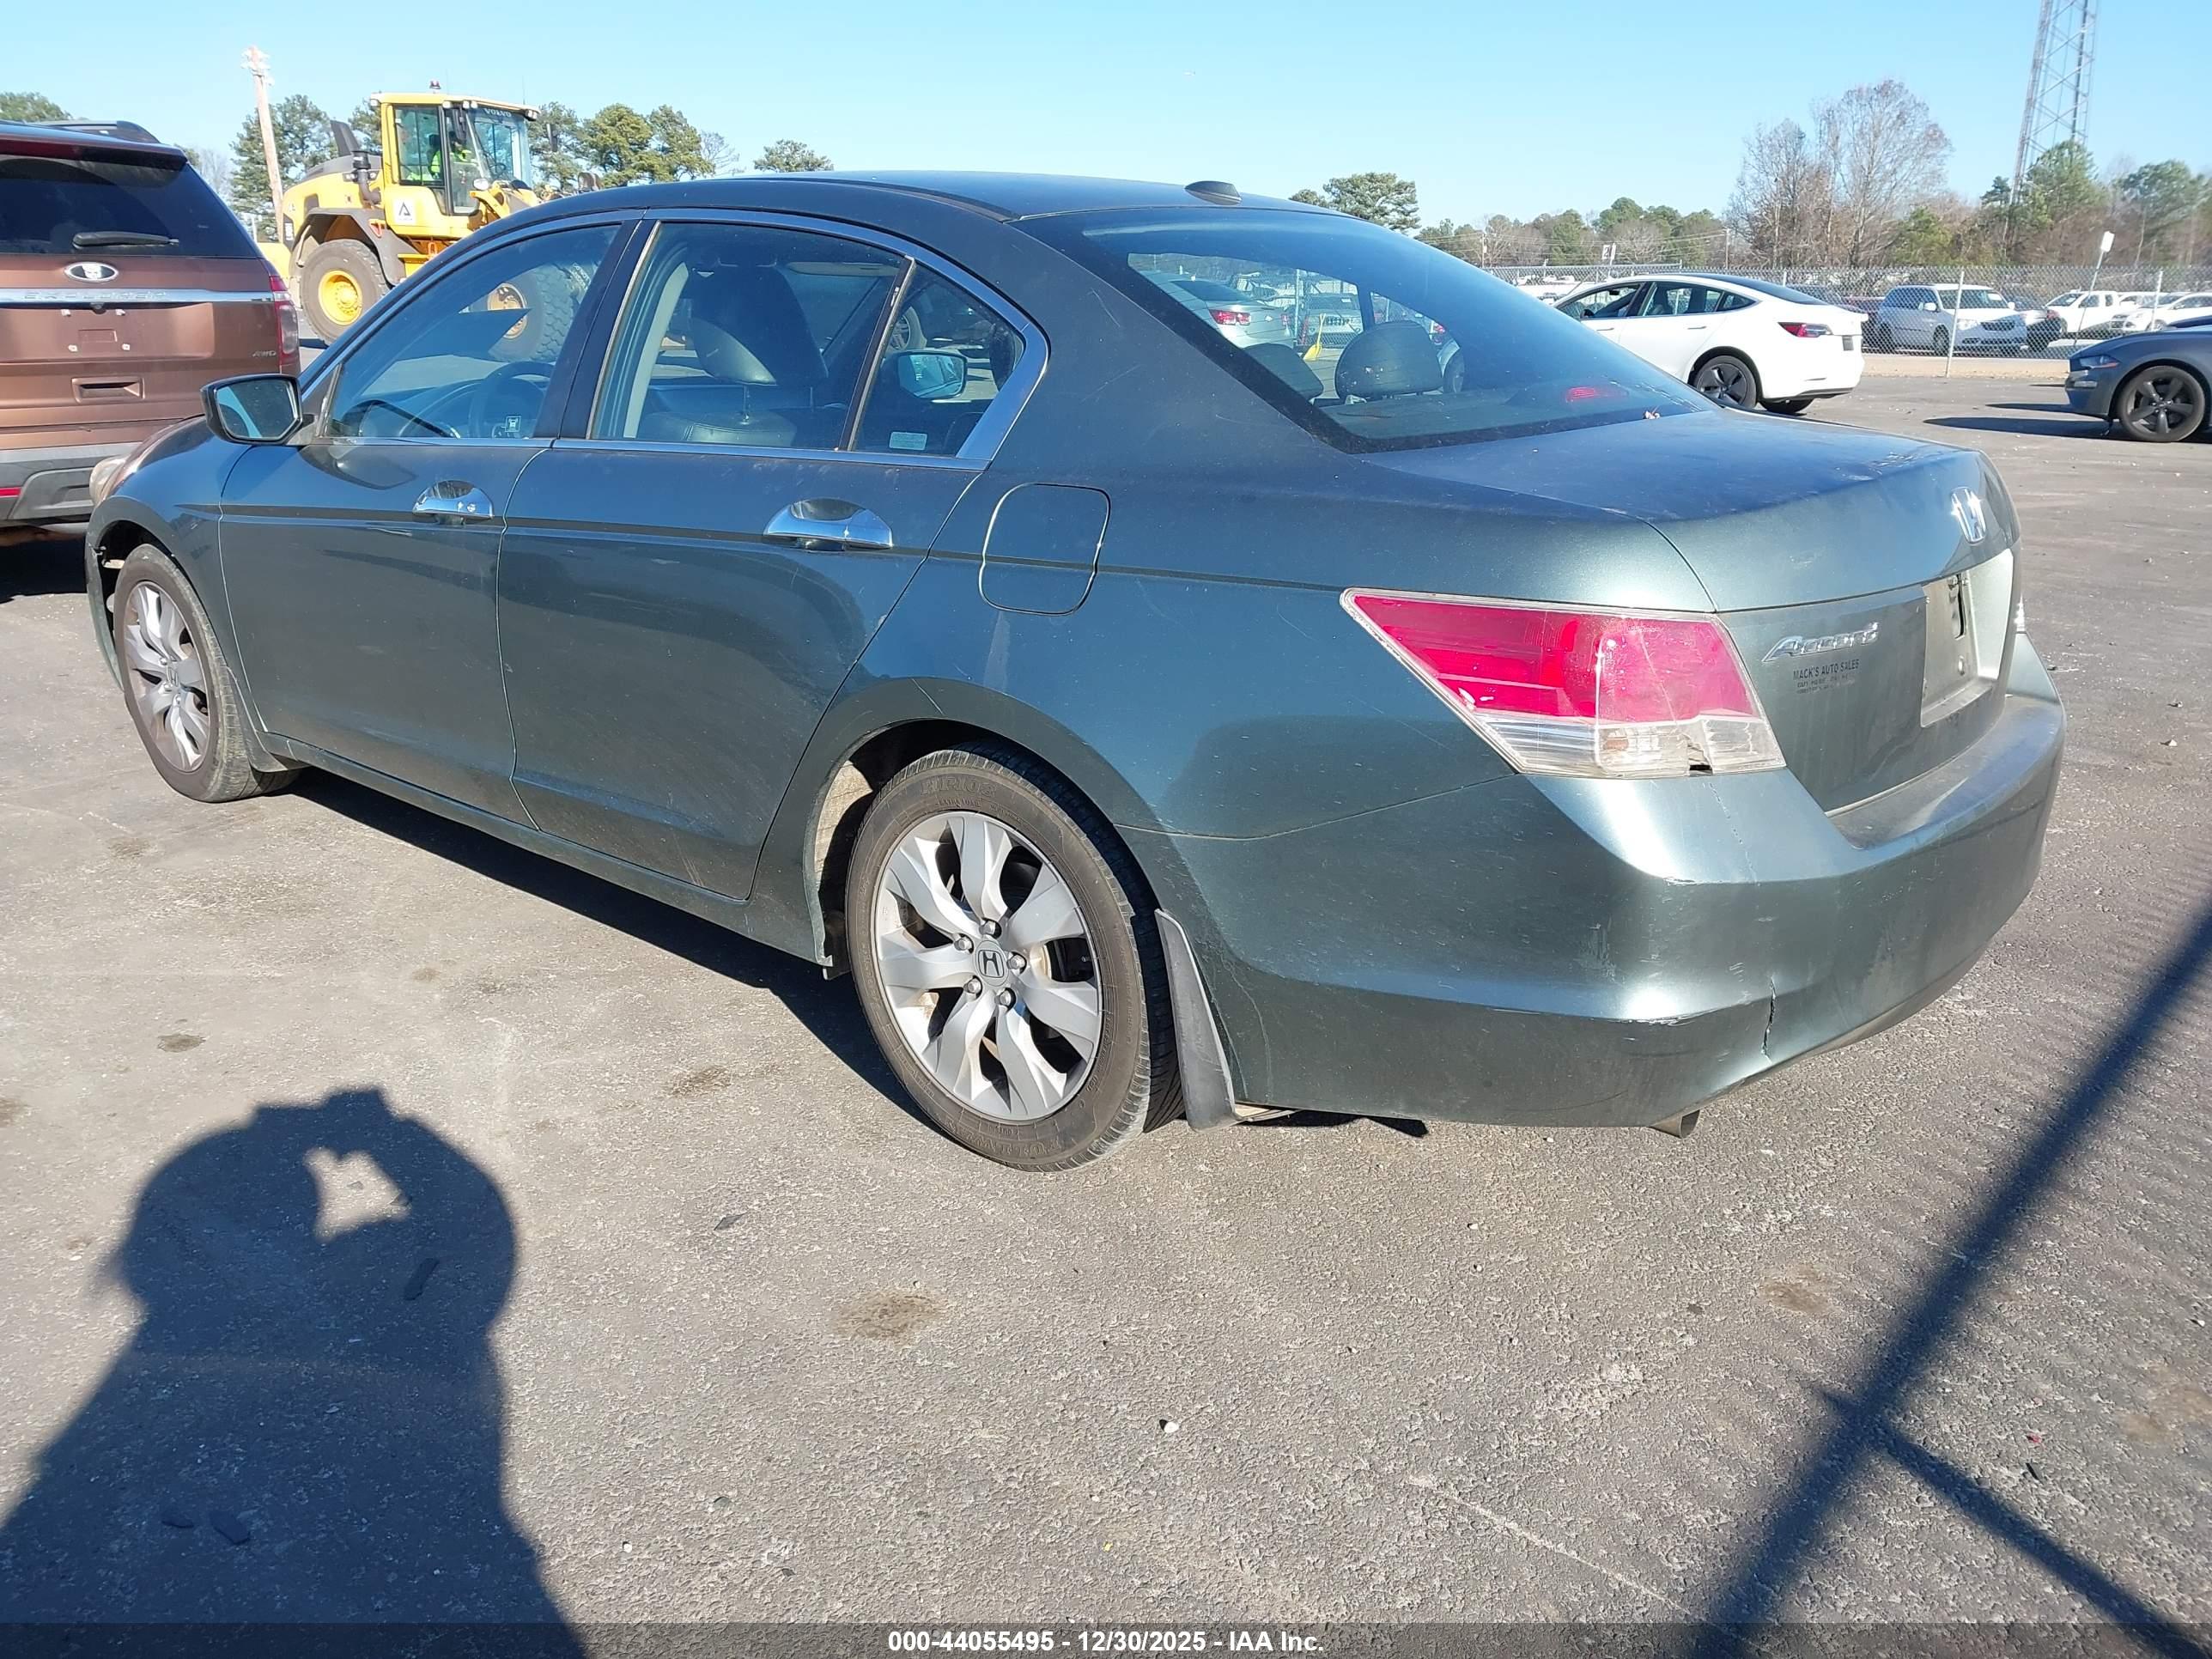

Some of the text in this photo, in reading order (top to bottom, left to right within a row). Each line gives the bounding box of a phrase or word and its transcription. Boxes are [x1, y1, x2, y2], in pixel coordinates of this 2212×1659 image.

[483, 107, 512, 118] VOLVO
[1761, 622, 1879, 663] Accord
[1793, 666, 1820, 681] MACK'S
[1821, 663, 1839, 675] AUTO
[1840, 659, 1860, 672] SALES
